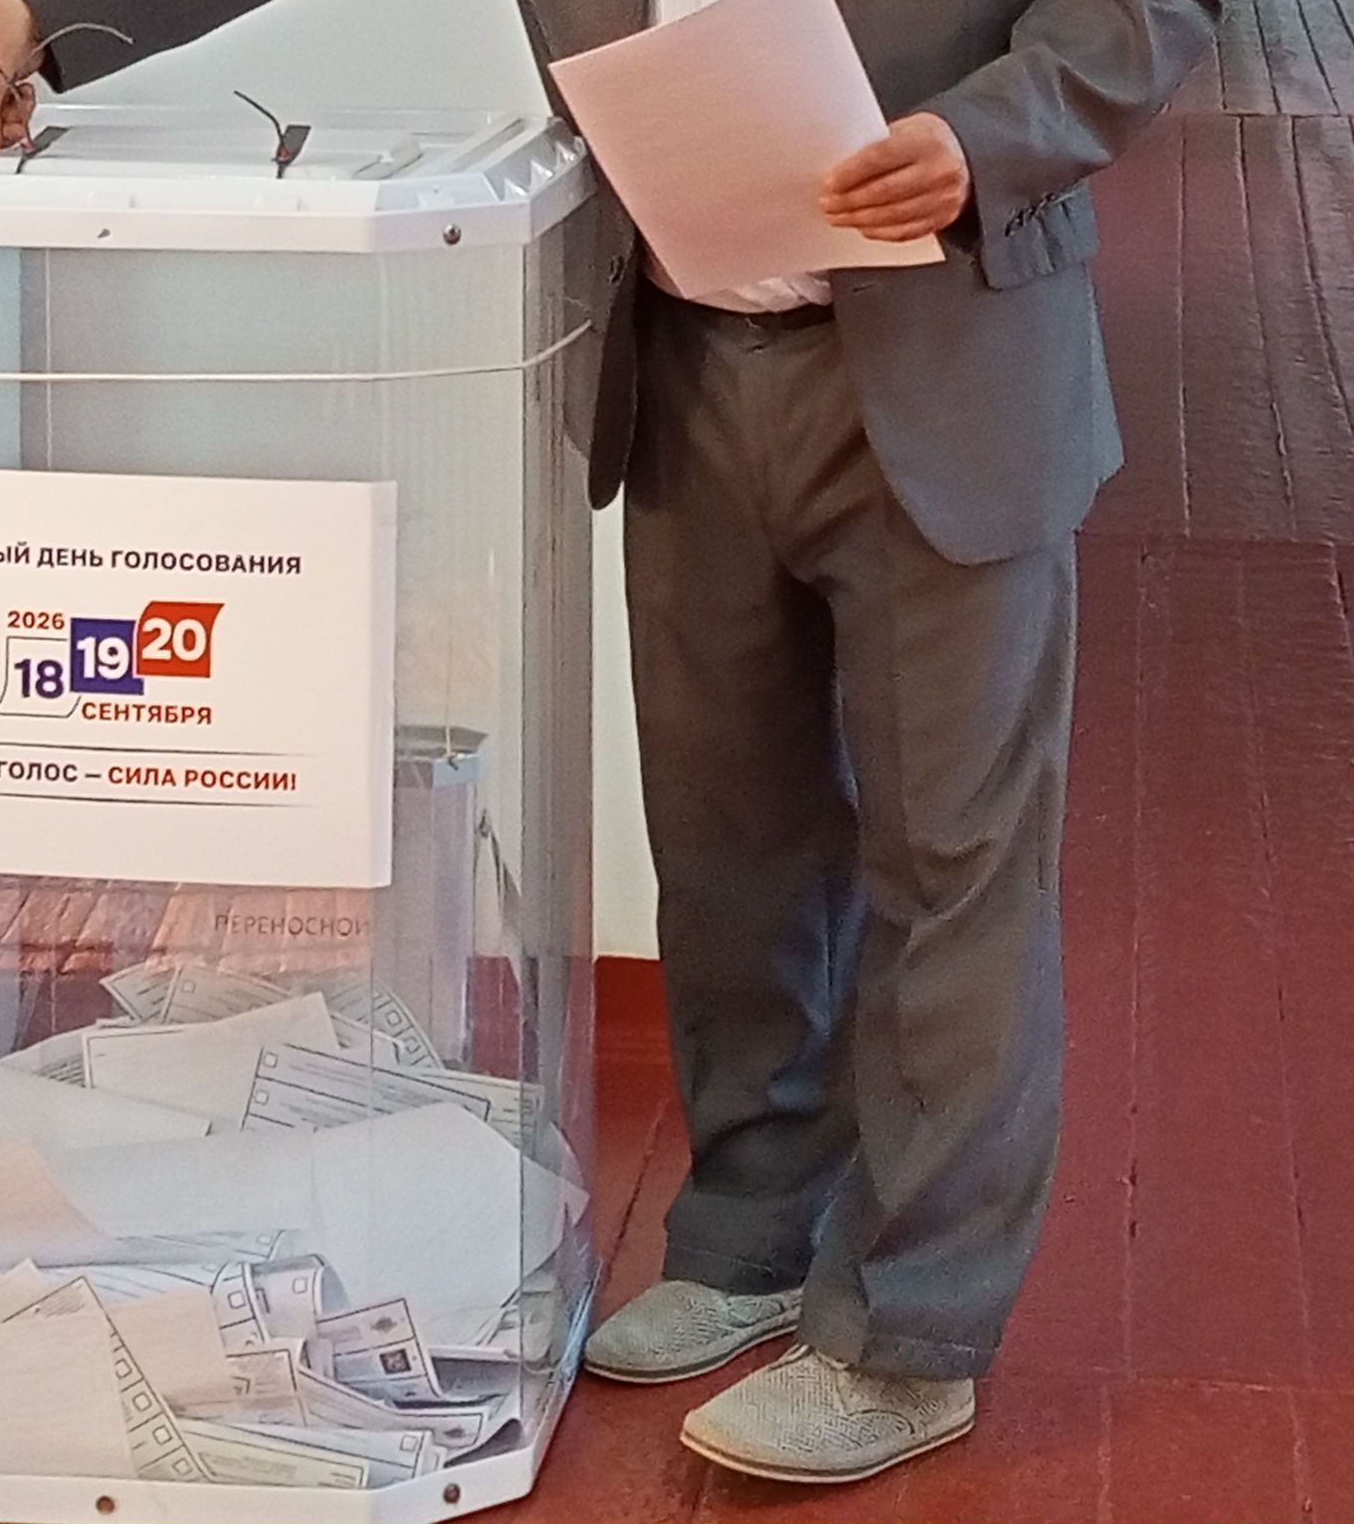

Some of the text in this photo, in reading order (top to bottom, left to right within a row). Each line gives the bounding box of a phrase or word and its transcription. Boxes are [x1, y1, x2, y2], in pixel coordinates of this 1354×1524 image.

[37, 546, 104, 569] ДЕНЬ
[111, 549, 302, 575] ГОЛОСОВАНИЯ
[7, 610, 65, 630] 2026
[14, 617, 207, 699] 18 19 20
[81, 702, 212, 725] СЕНТЯБРЯ
[108, 766, 177, 787] СИЛА
[184, 769, 297, 791] РОССИИ!
